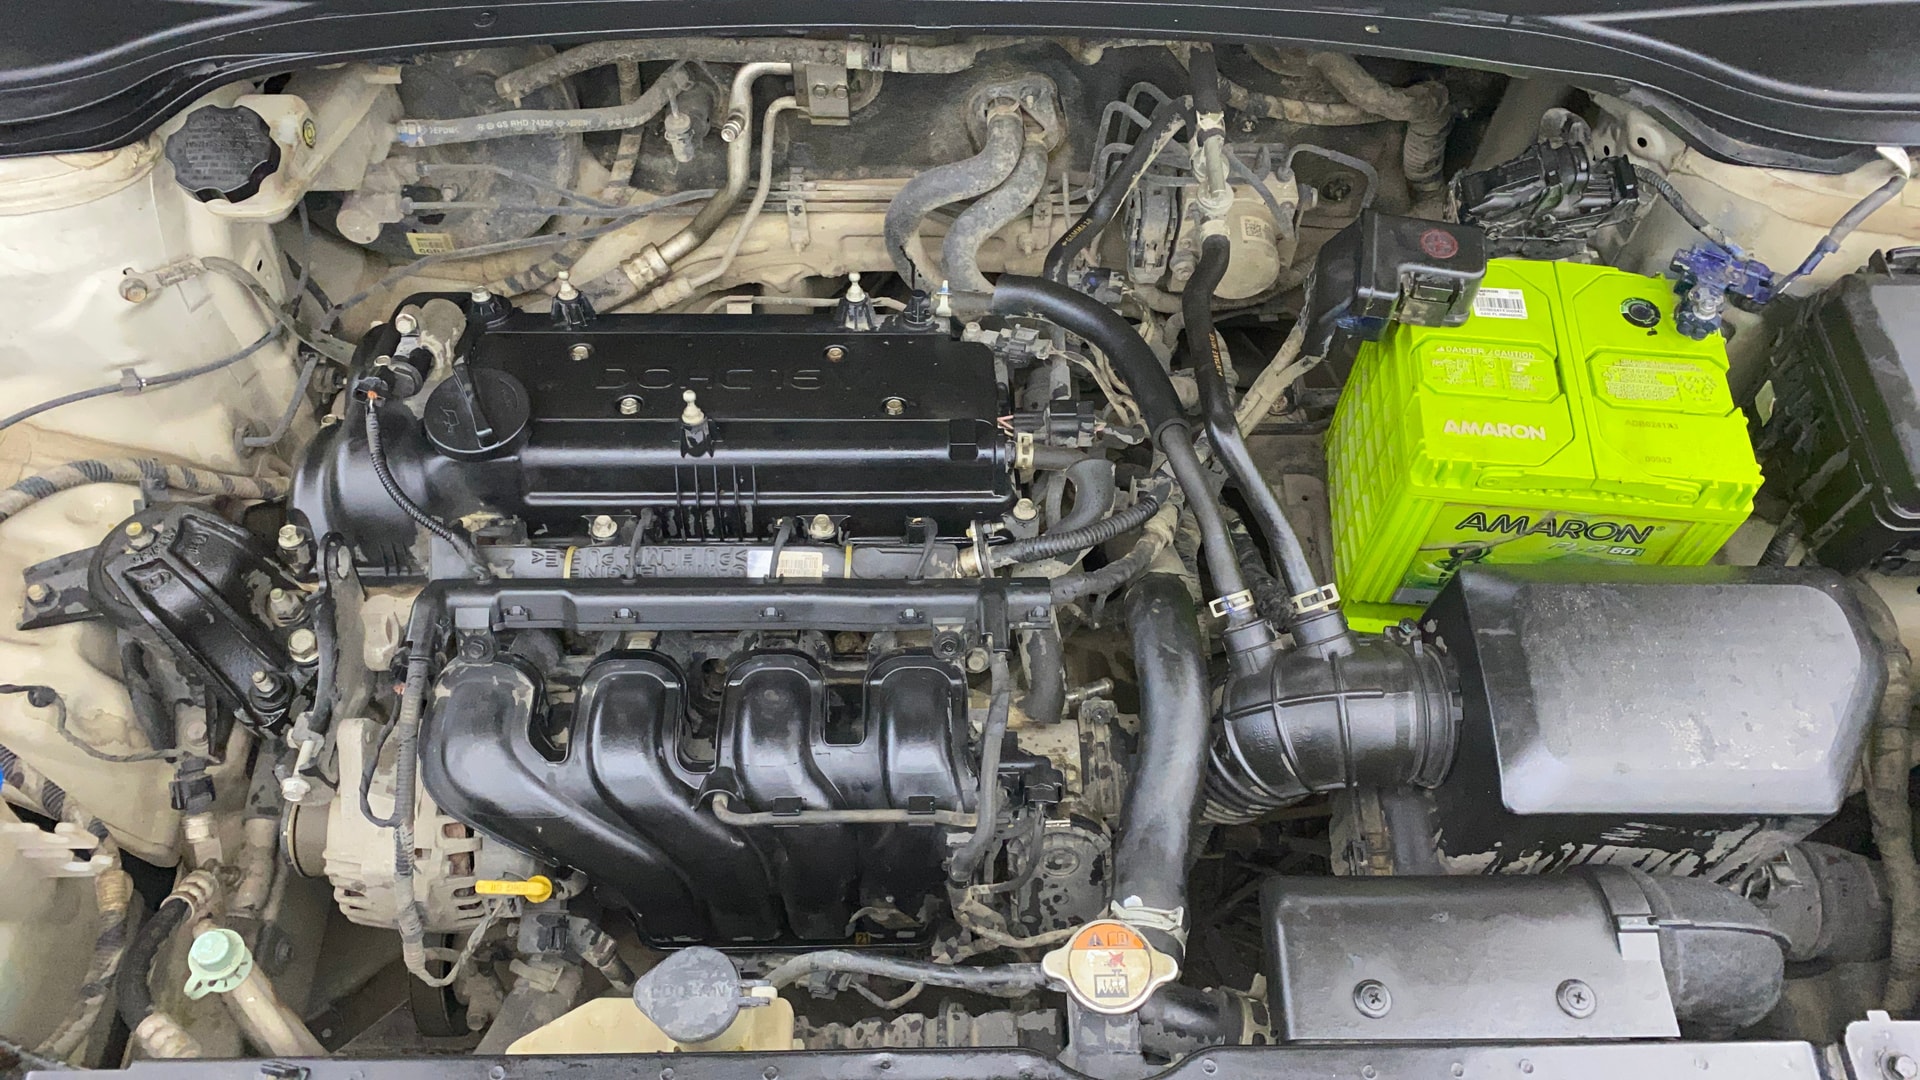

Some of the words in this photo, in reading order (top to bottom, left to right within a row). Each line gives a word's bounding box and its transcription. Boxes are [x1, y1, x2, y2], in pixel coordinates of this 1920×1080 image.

[1445, 345, 1485, 355] DANGER
[1494, 349, 1535, 360] CAUTION
[594, 368, 753, 391] DOHC
[1443, 419, 1547, 441] AMARON
[1454, 511, 1655, 545] AMARON
